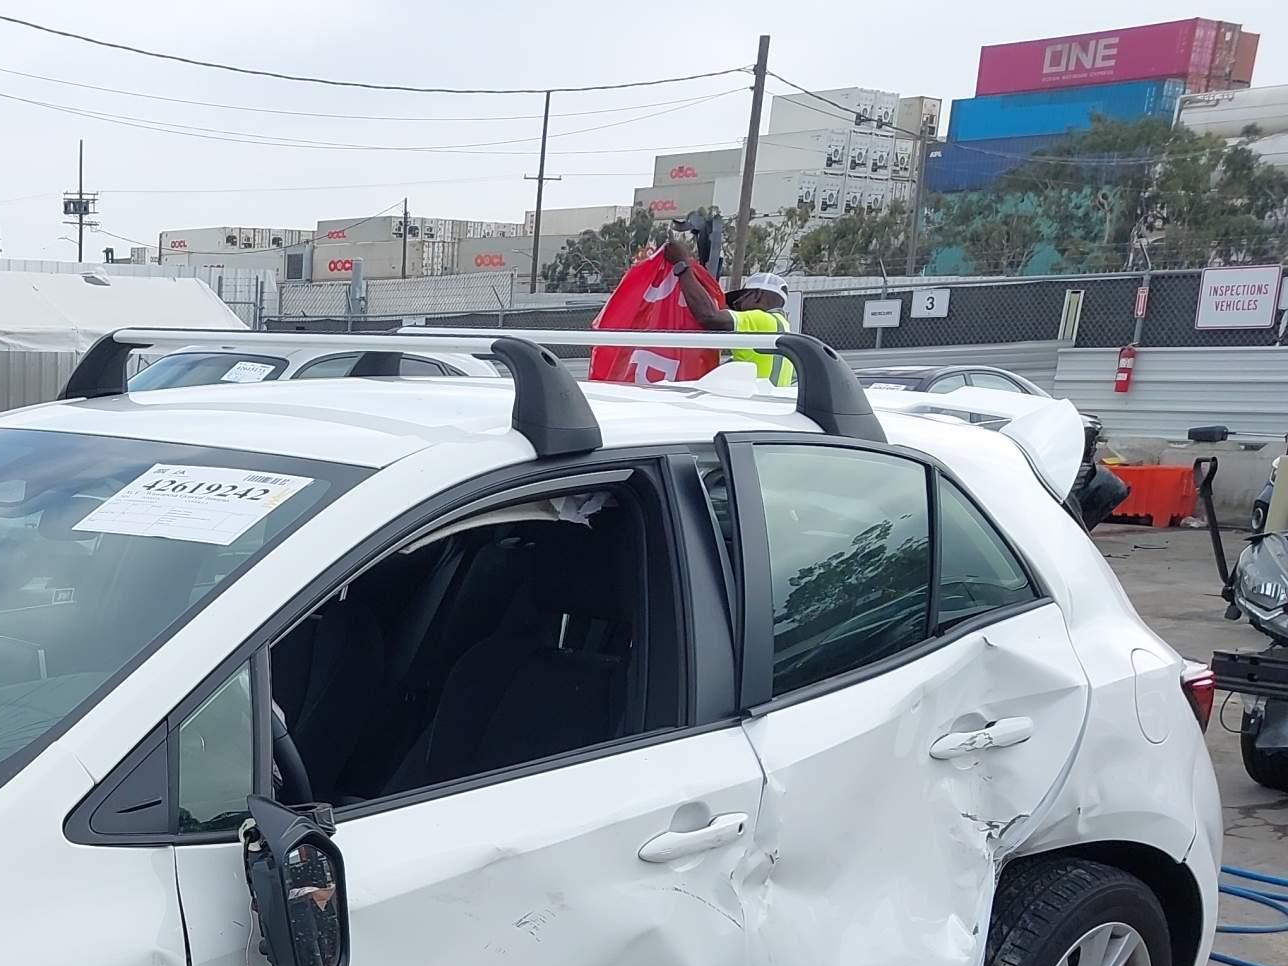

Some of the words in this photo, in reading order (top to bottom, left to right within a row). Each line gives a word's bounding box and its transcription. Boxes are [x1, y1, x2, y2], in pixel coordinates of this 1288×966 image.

[1042, 37, 1120, 74] ONE
[1209, 284, 1269, 297] INSPECTIONS
[925, 296, 935, 310] 3
[1215, 300, 1258, 312] VEHICLES
[143, 479, 270, 501] 42619242
